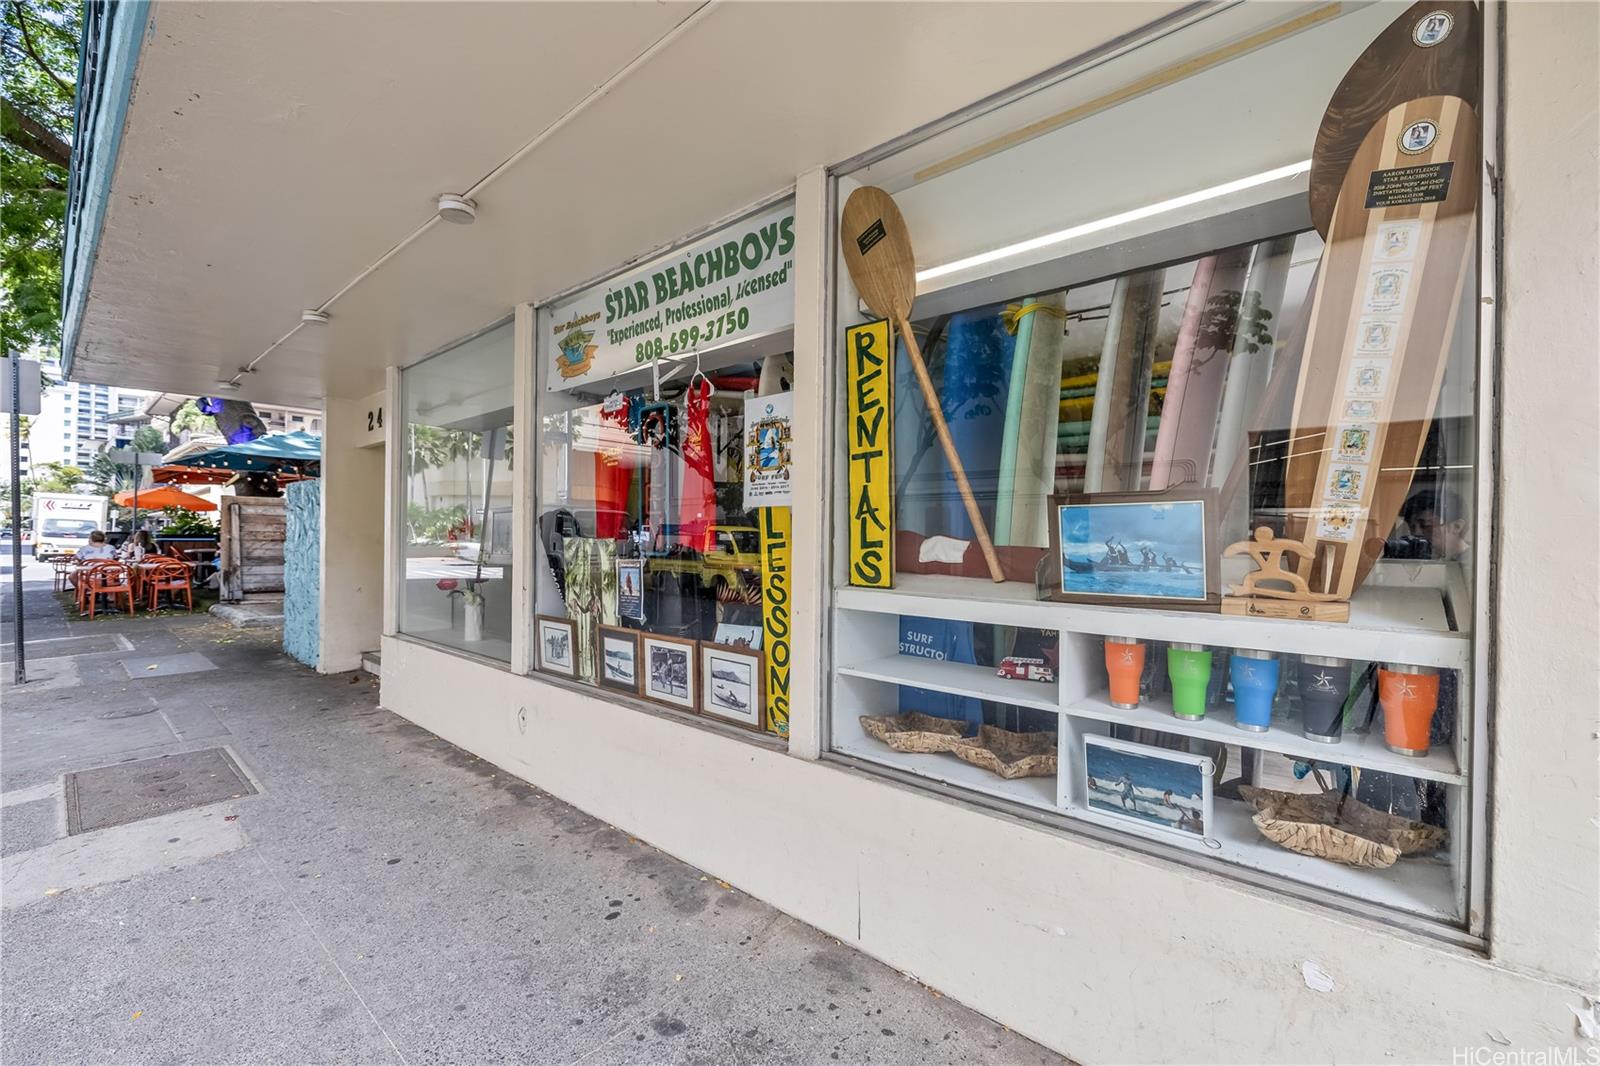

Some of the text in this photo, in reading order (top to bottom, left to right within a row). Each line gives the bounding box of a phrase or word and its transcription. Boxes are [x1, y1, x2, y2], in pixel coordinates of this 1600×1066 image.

[1407, 166, 1441, 174] RUTLEDGE
[605, 281, 649, 324] STAR
[652, 216, 795, 305] BEACHBOYS
[553, 312, 601, 335] Star Beachboys
[607, 260, 793, 345] "Experienced, Professional, Licensed"
[635, 307, 749, 362] 808-699-3750
[368, 408, 383, 431] 24
[851, 331, 887, 583] RENTALS
[765, 507, 790, 728] LESSONS
[906, 631, 934, 645] SURF
